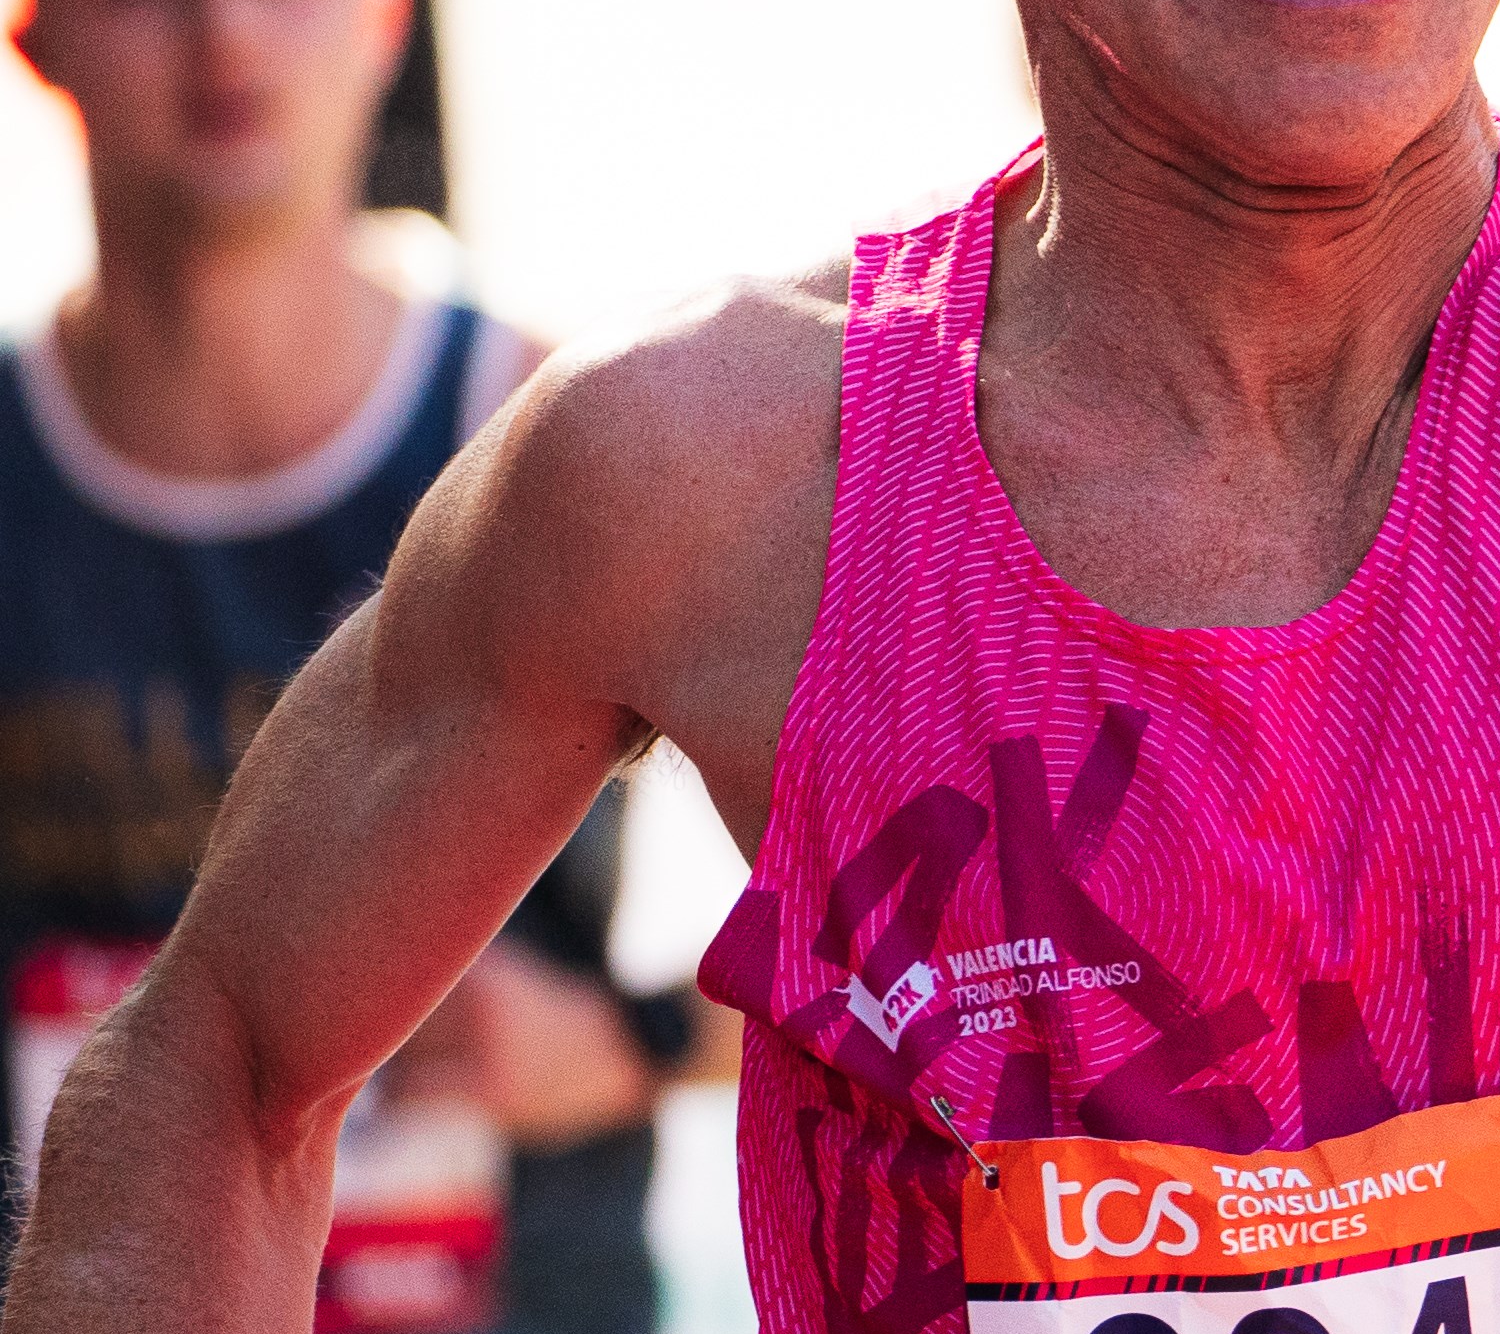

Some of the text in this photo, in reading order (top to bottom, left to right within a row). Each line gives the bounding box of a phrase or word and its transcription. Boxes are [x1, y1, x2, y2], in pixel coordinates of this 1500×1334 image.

[946, 936, 1057, 981] VALENCIA
[951, 961, 1141, 1009] TRINIDAD ALFONSO
[958, 1006, 1018, 1037] 2023
[1212, 1165, 1312, 1191] TATA
[1216, 1160, 1447, 1220] CONSULTANCY
[1042, 1161, 1199, 1259] tcs
[1220, 1213, 1367, 1256] SERVICES
